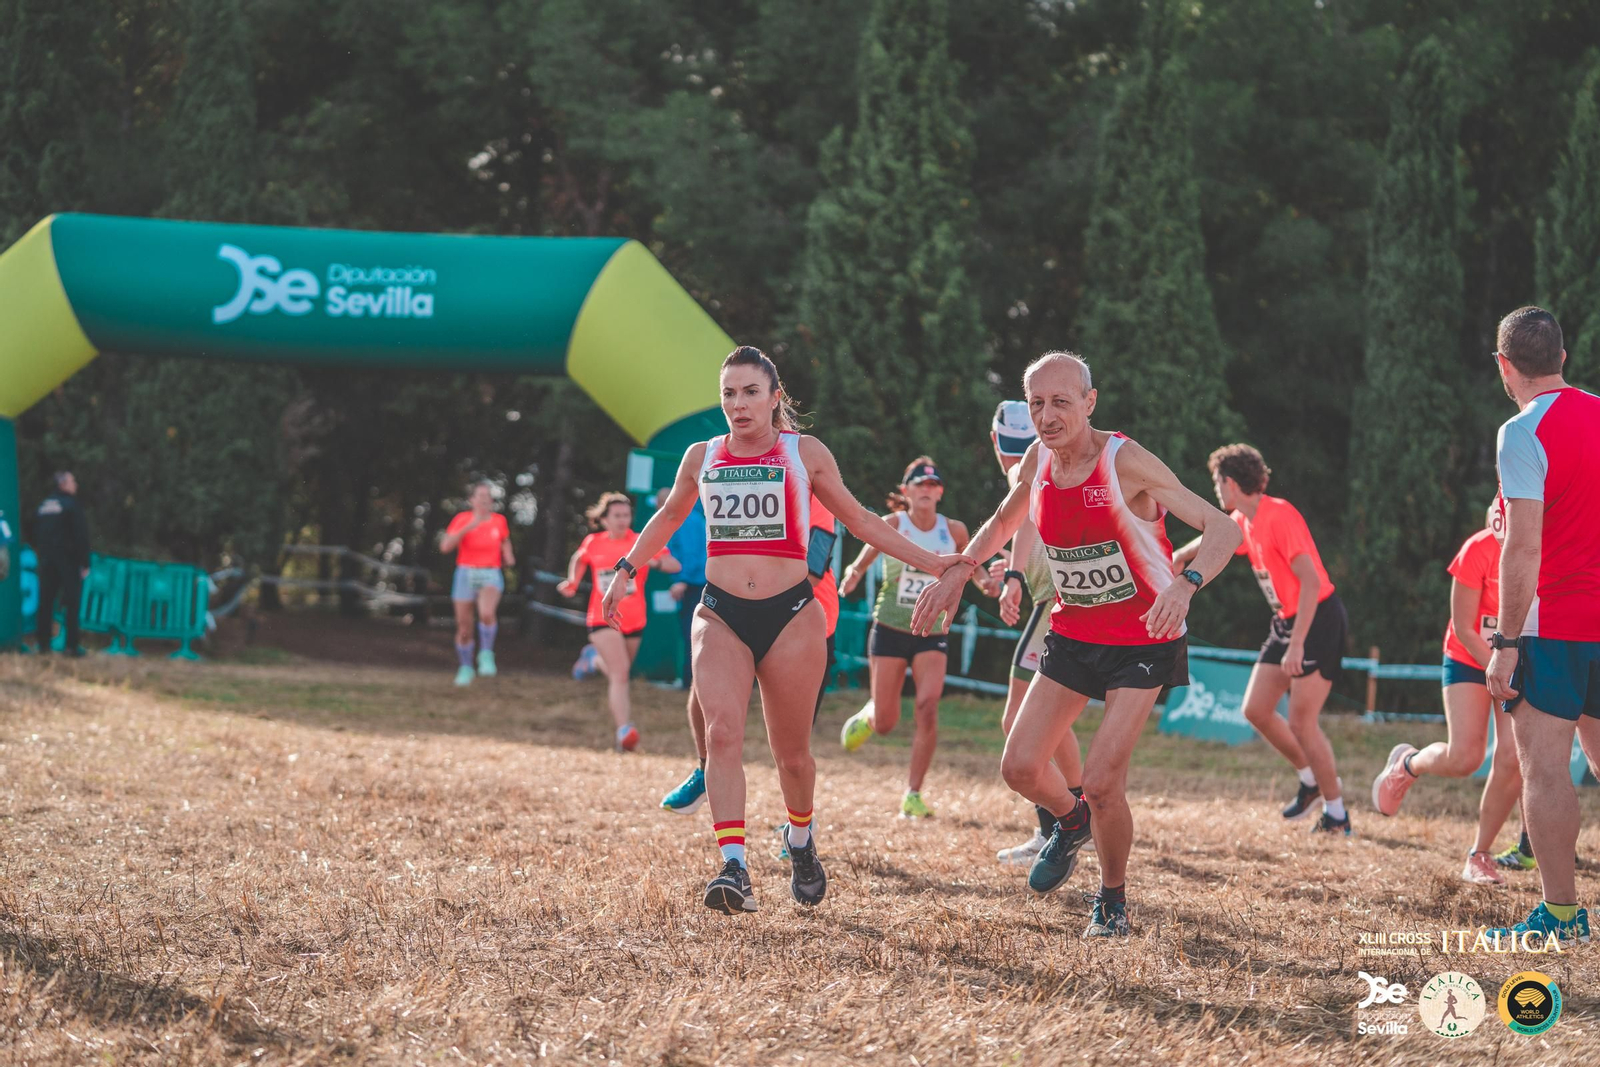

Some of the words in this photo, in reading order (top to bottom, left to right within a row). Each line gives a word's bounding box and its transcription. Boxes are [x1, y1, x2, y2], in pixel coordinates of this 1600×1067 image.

[327, 263, 437, 286] Diputación
[326, 285, 434, 317] Sevilla
[723, 468, 763, 478] ITÁLICA
[710, 493, 779, 519] 2200
[1060, 547, 1098, 559] ITÁLICA
[1056, 564, 1125, 590] 2200
